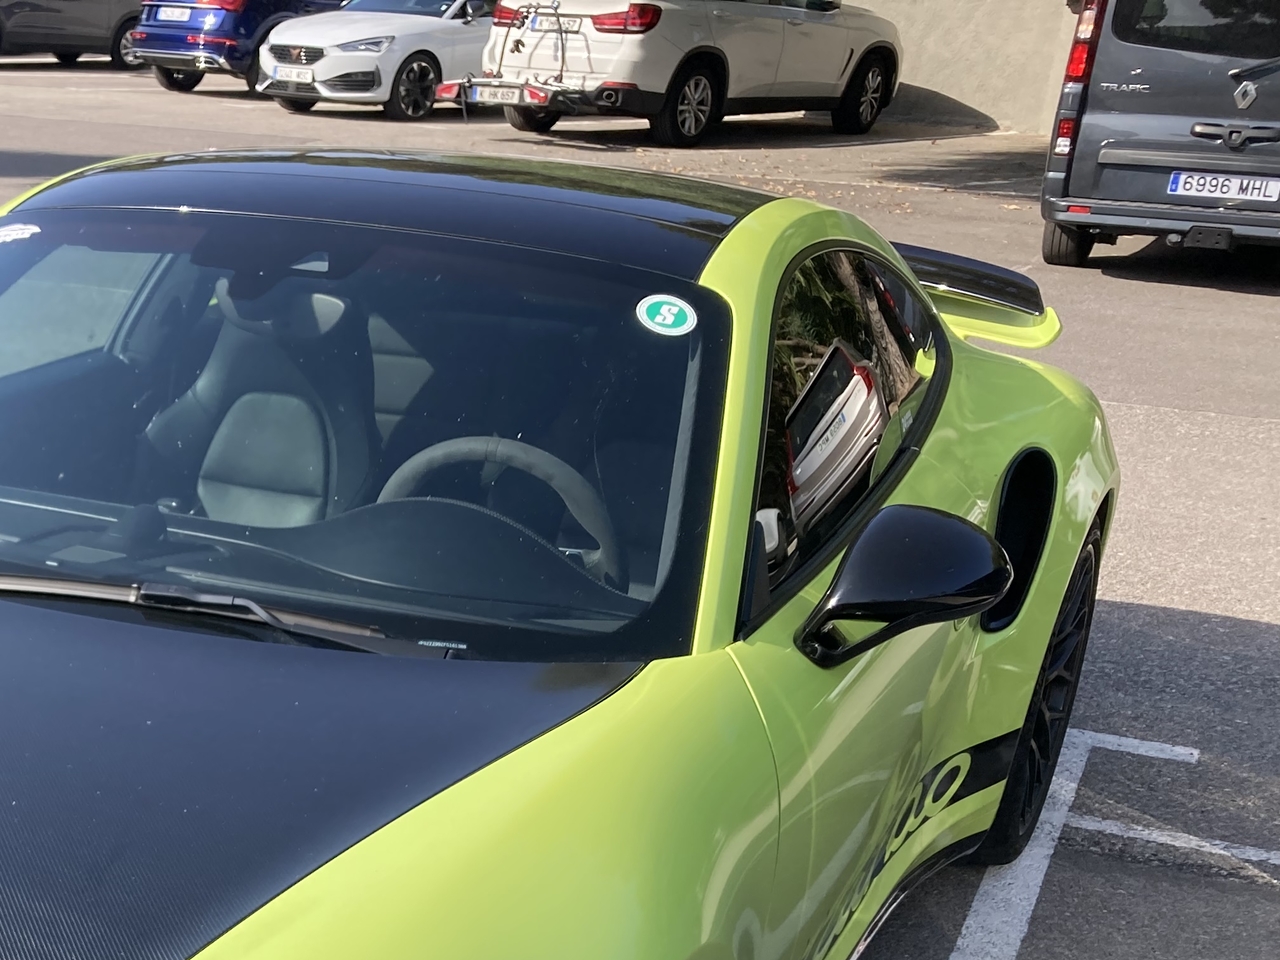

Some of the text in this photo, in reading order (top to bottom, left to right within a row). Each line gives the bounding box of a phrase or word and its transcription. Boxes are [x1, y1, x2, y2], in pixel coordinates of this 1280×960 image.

[1100, 82, 1150, 93] TRAFIC
[1183, 175, 1273, 198] 6996 MHL
[653, 304, 680, 325] S
